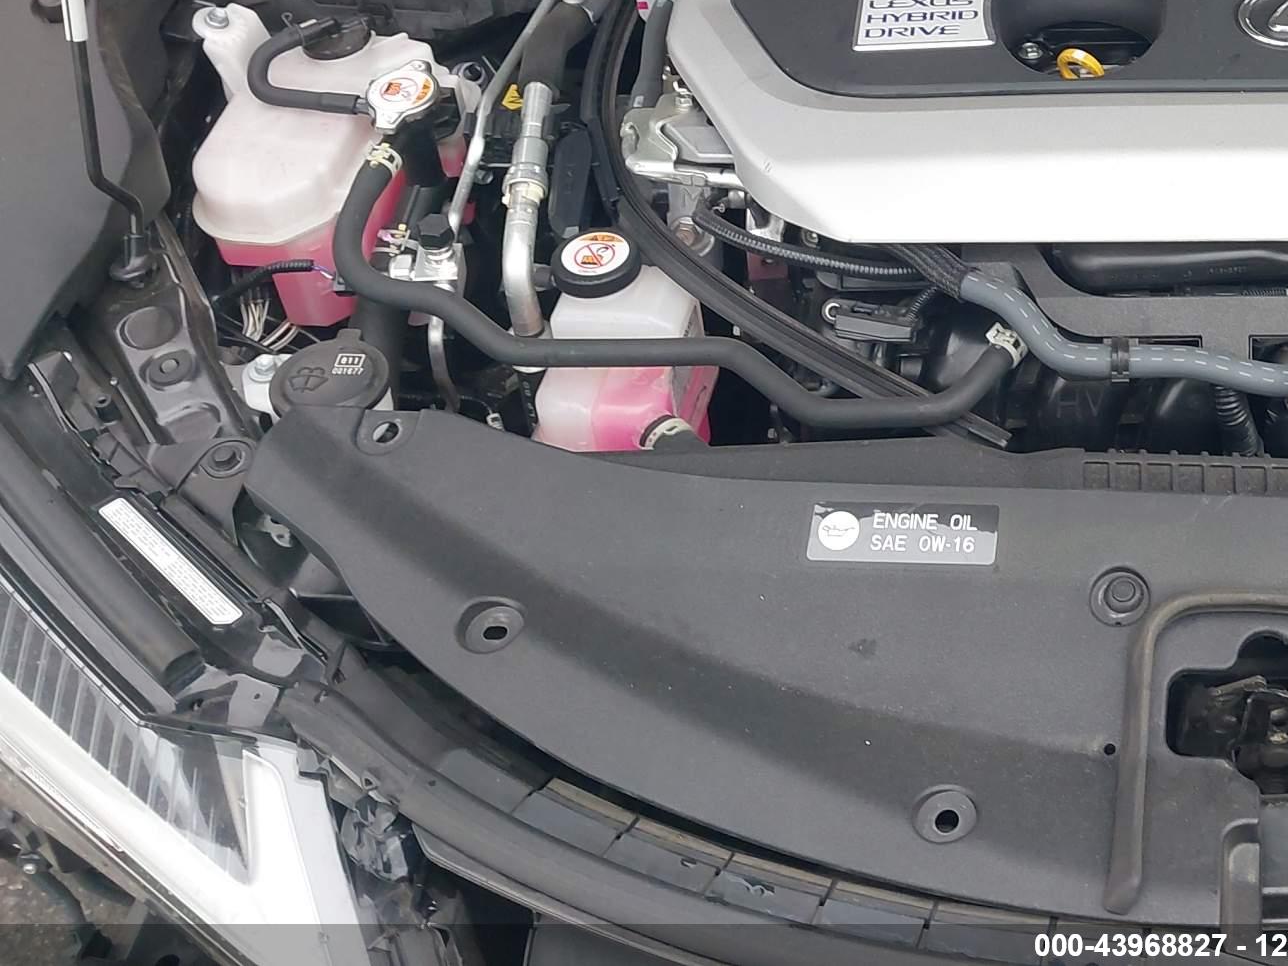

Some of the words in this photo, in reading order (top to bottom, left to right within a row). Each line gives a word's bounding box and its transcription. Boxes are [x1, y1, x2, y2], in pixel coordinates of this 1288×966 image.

[867, 10, 978, 24] HYBRID
[865, 25, 960, 38] DRIVE
[873, 512, 939, 530] ENGINE
[950, 514, 978, 531] OIL
[870, 534, 908, 552] SAE
[919, 535, 976, 553] 0W-16
